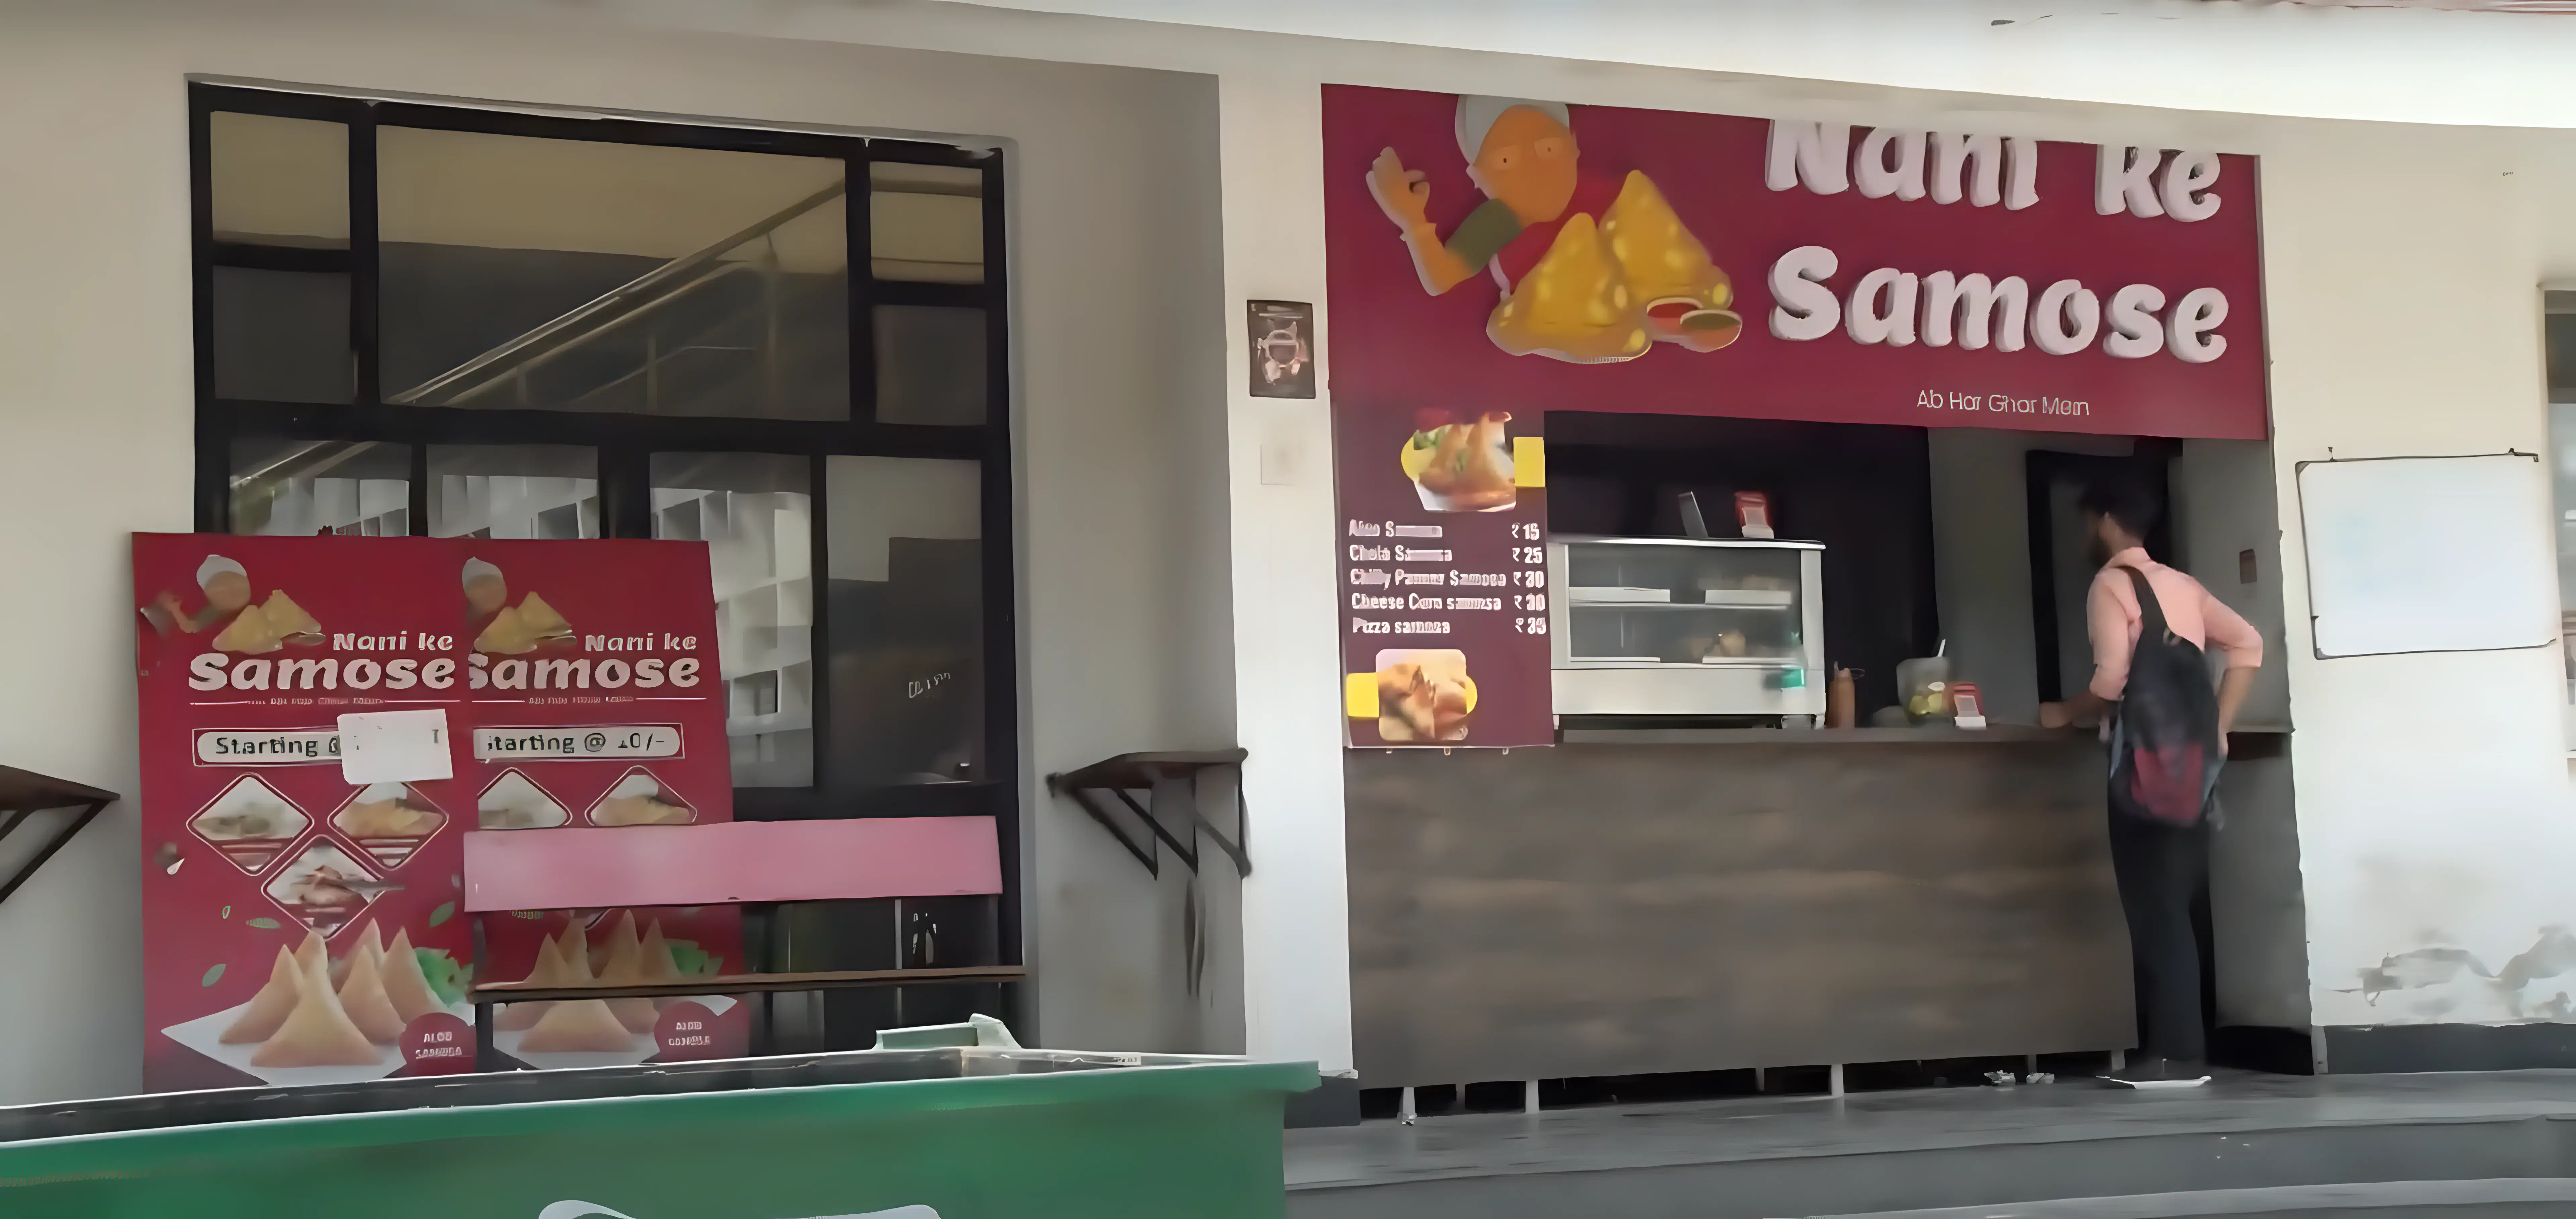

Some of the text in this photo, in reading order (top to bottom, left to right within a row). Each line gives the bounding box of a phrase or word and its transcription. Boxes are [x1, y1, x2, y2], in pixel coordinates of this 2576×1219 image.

[1768, 246, 2229, 363] Samose
[1917, 389, 1943, 408] Ab
[1950, 392, 1981, 410] Har
[333, 630, 453, 651] Nani ke
[585, 633, 697, 651] Nani ke
[189, 652, 455, 691] Samose
[215, 736, 318, 758] Starting
[488, 735, 575, 754] tarting
